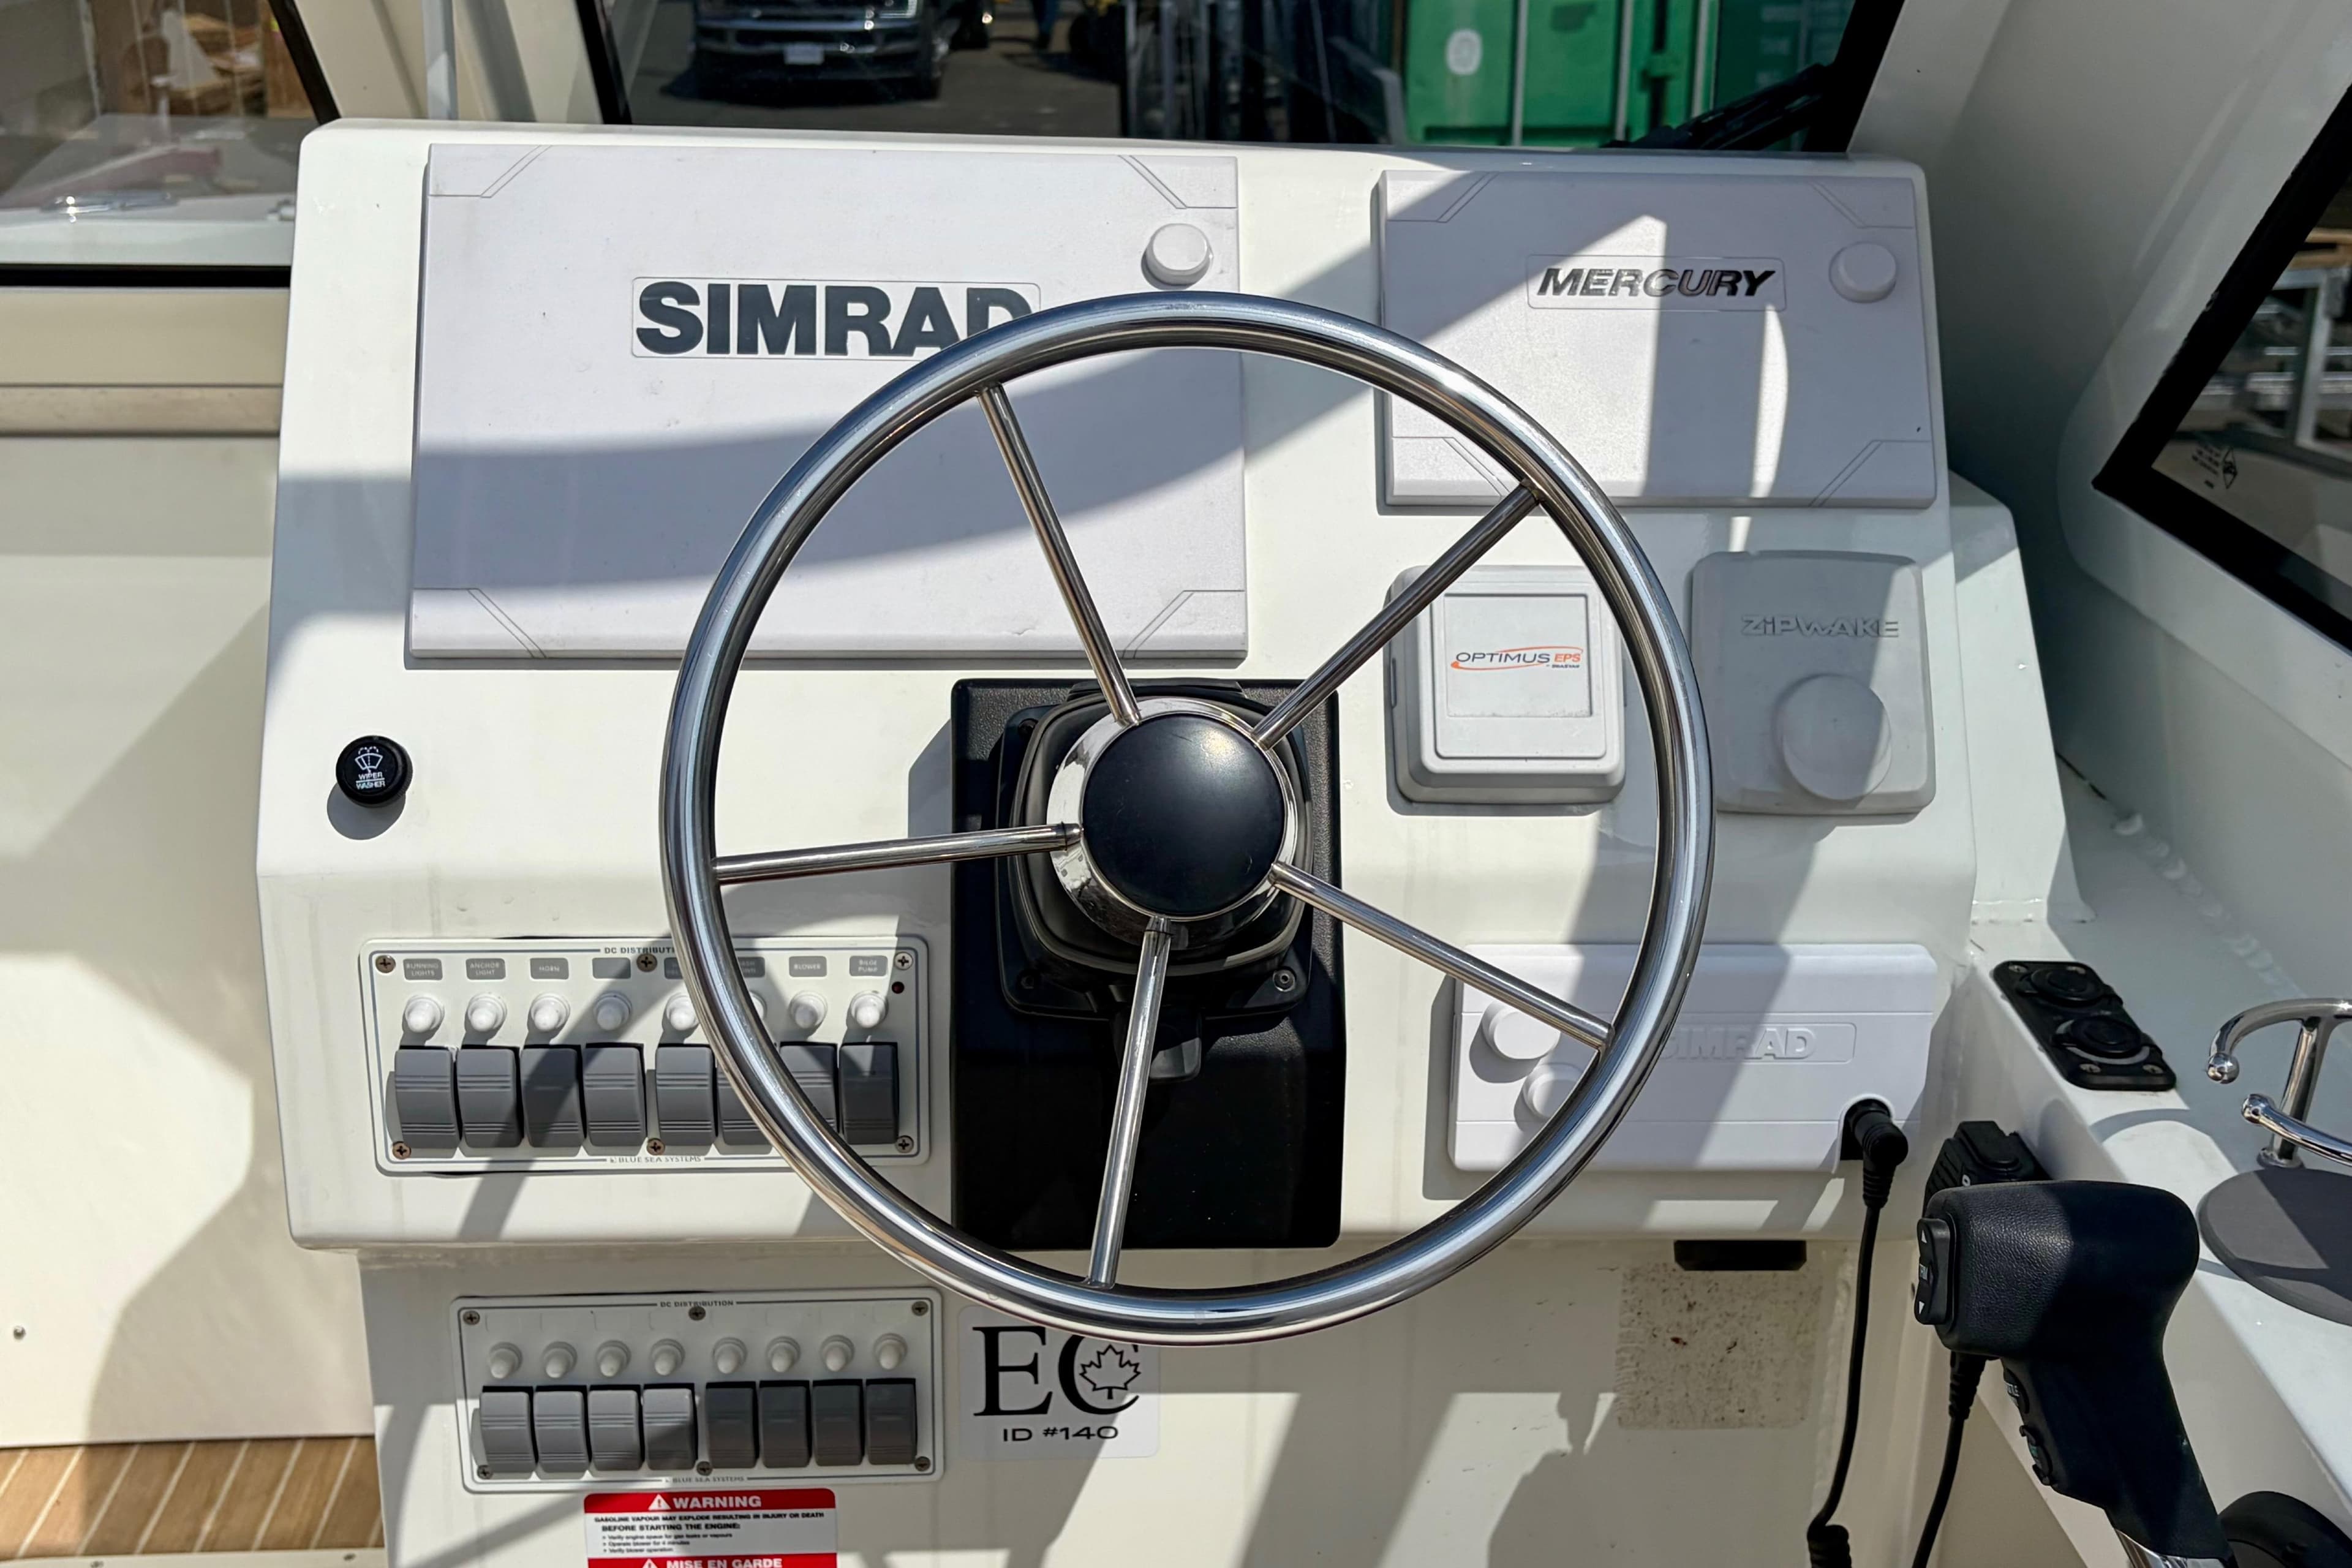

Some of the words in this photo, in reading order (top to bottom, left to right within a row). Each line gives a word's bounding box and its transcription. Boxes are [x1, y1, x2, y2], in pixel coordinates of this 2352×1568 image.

[1537, 268, 1776, 297] MERCURY
[636, 281, 1033, 357] SIMRAD
[1455, 652, 1550, 663] OPTIMUS
[1554, 653, 1581, 663] EPS
[356, 781, 385, 790] WASHER
[972, 1325, 1140, 1416] EC
[1003, 1428, 1033, 1441] ID
[1042, 1425, 1118, 1440] #140
[673, 1496, 762, 1509] WARNING
[666, 1559, 703, 1568] MISE
[707, 1559, 727, 1568] EN
[732, 1558, 783, 1568] GARDE
